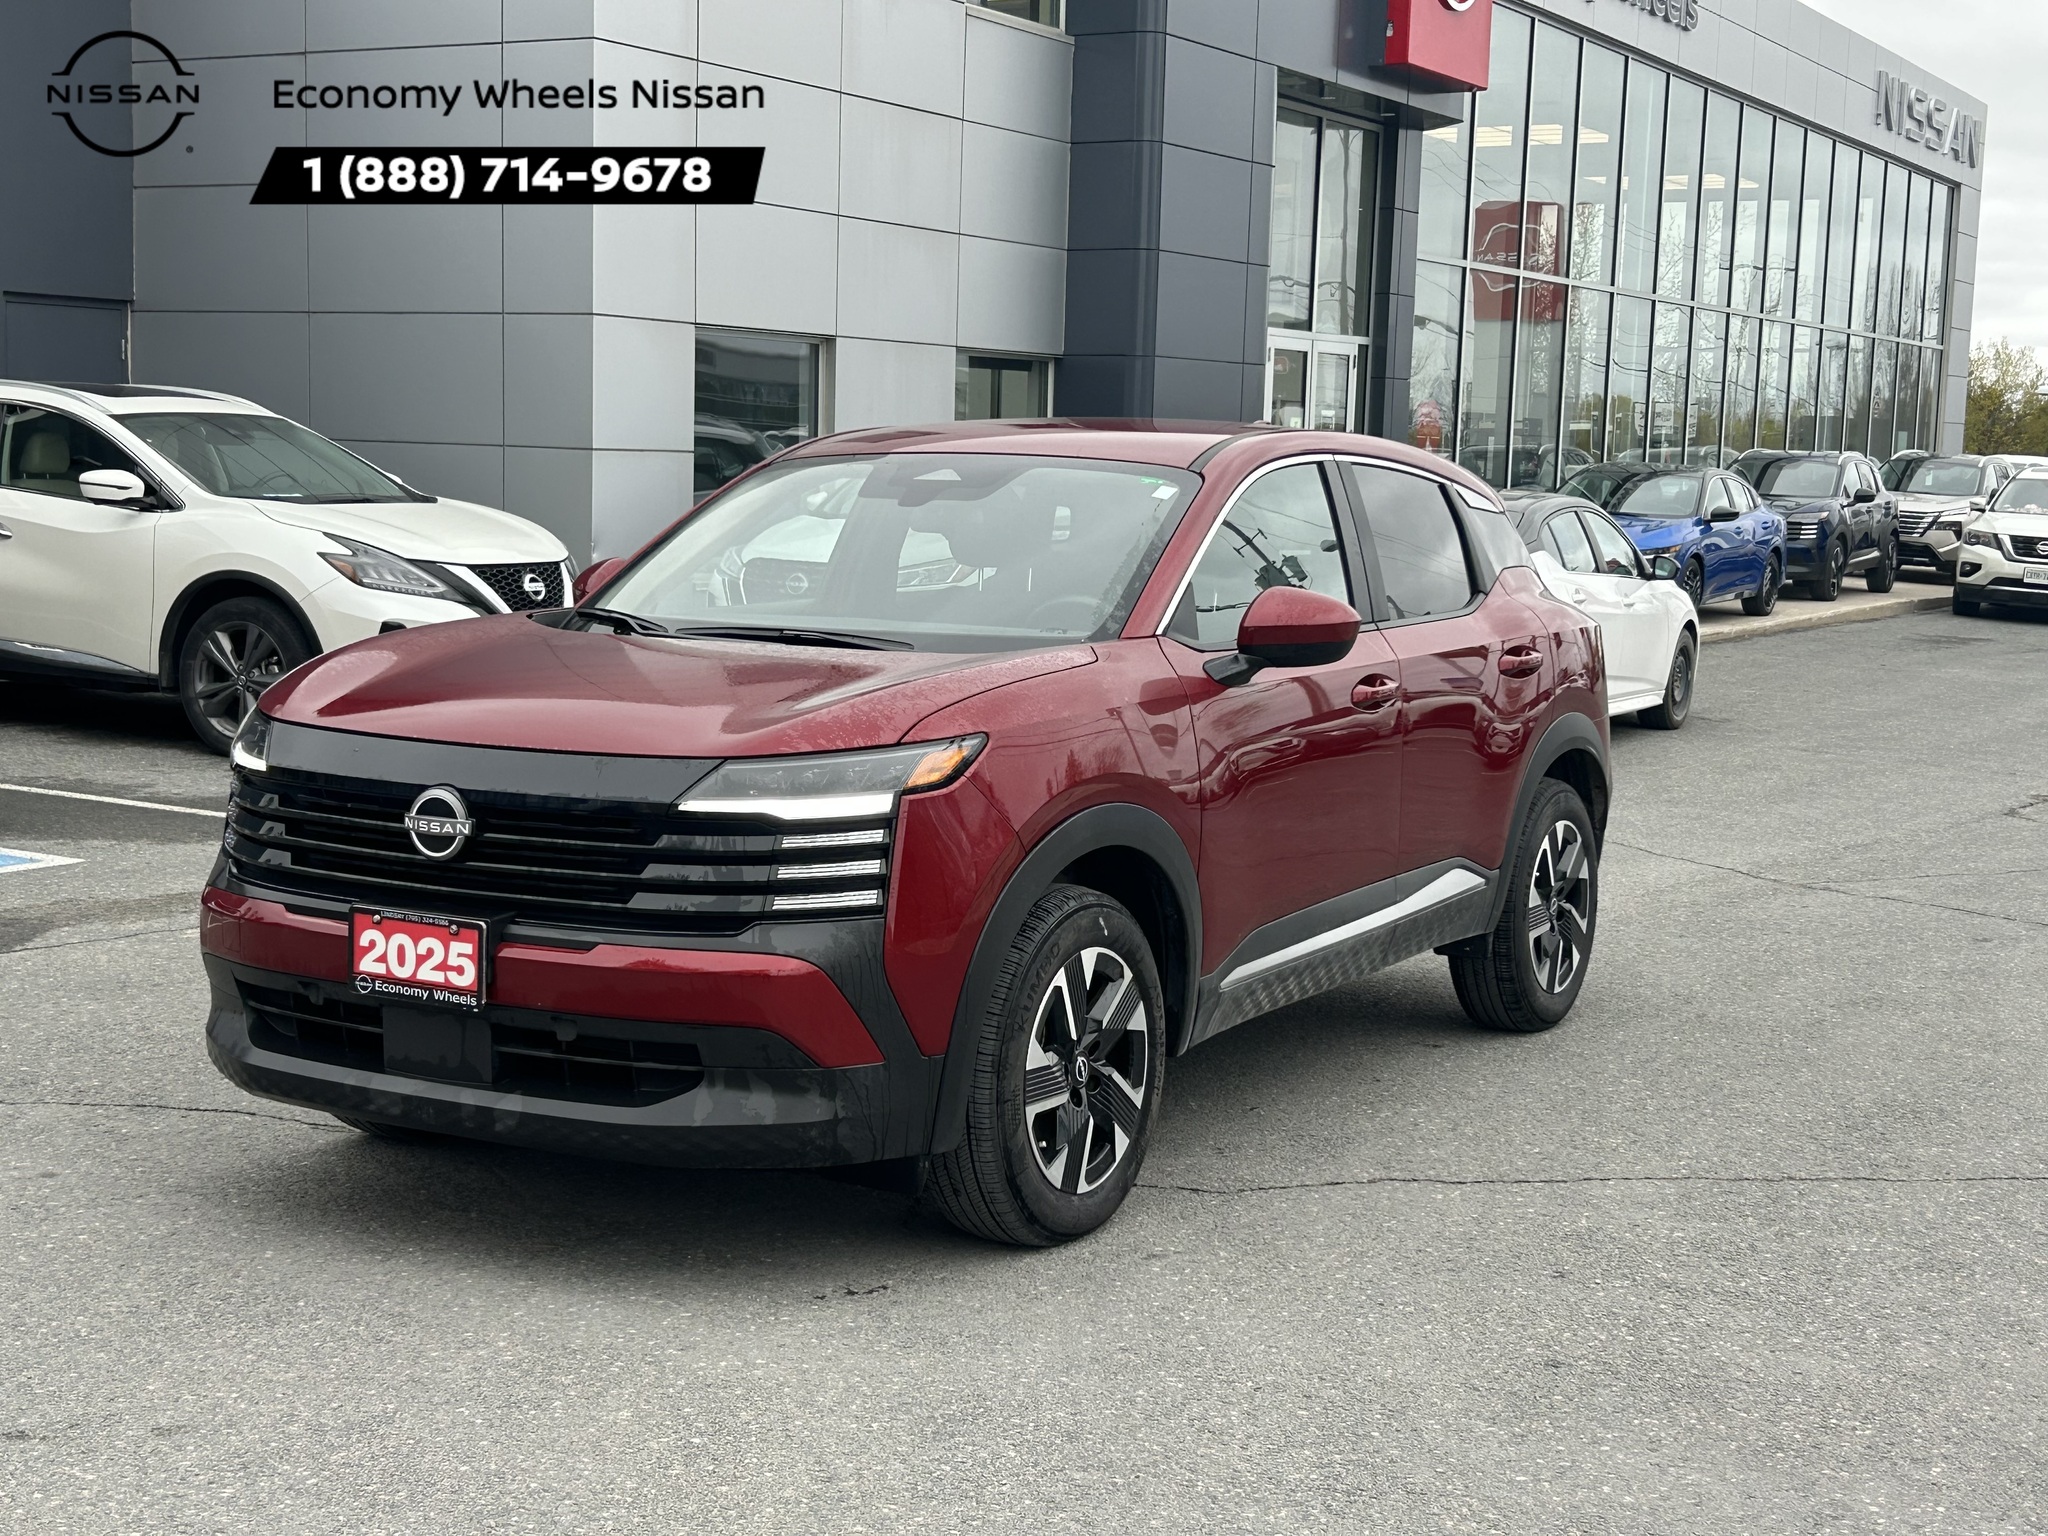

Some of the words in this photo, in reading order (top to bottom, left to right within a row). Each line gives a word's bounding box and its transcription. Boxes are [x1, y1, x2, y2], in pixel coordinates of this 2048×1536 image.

[1876, 70, 1983, 169] NISSAN
[404, 816, 469, 834] NISSAN
[358, 928, 476, 987] 2025
[1014, 942, 1061, 1032] KUMHO
[375, 980, 430, 1000] Economy
[433, 989, 477, 1006] Wheels
